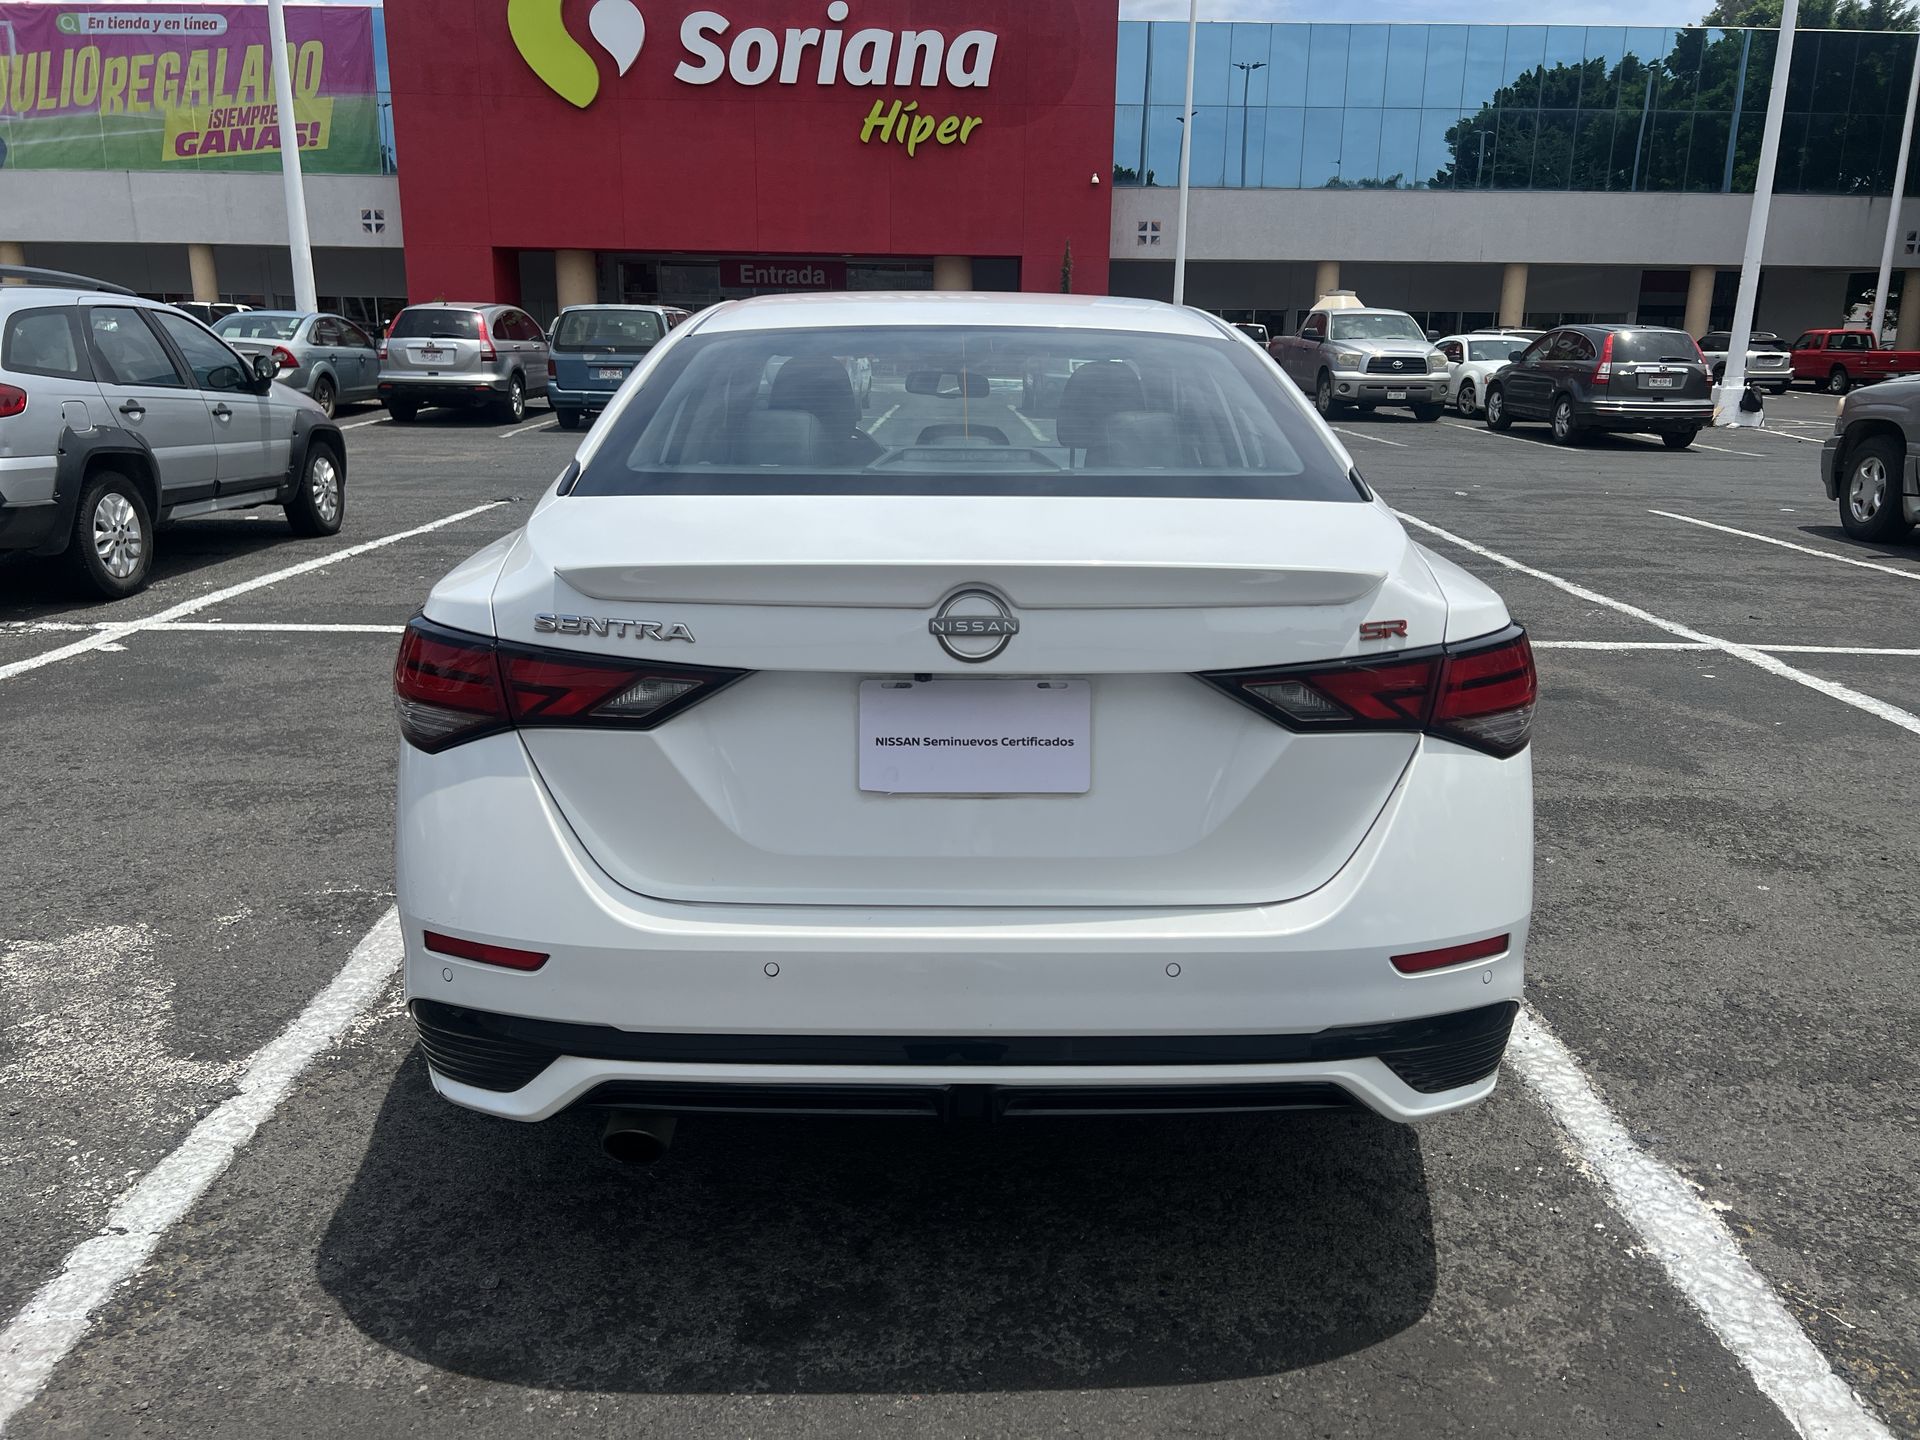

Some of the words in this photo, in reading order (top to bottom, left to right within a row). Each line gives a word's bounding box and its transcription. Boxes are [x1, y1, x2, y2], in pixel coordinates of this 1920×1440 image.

[88, 16, 104, 30] En
[107, 16, 150, 30] tienda
[152, 19, 161, 33] y
[164, 19, 180, 30] en
[184, 16, 218, 31] línea
[673, 0, 998, 88] Soriana
[207, 103, 279, 129] ¡SIEMPRE
[860, 99, 982, 157] Híper
[738, 263, 826, 285] Entrada
[534, 612, 696, 644] SENTRA
[931, 621, 1017, 632] NISSAN
[1360, 619, 1408, 641] SR
[875, 736, 921, 747] NISSAN
[922, 736, 999, 747] Seminuevos
[1001, 736, 1075, 747] Certificados
